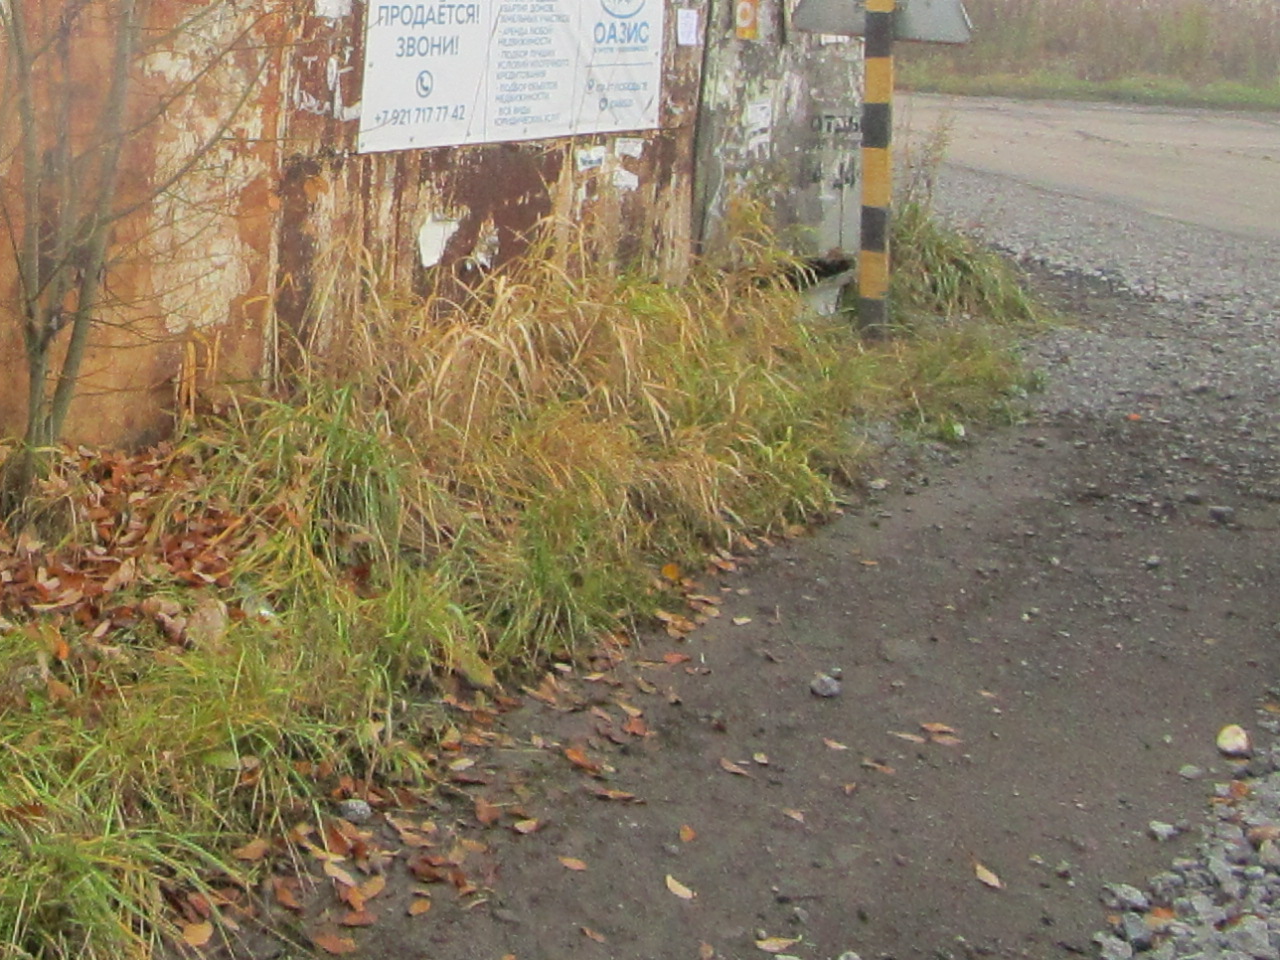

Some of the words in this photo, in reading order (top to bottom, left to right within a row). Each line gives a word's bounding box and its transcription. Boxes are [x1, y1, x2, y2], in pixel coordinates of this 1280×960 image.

[378, 0, 480, 29] ПРОДАЁТСЯ!
[594, 21, 650, 44] ОАЗИС
[396, 36, 459, 58] ЗВОНИ!
[375, 111, 388, 127] +7
[391, 109, 411, 125] 921
[415, 107, 433, 124] 717
[436, 106, 449, 122] 77
[451, 105, 465, 120] 42
